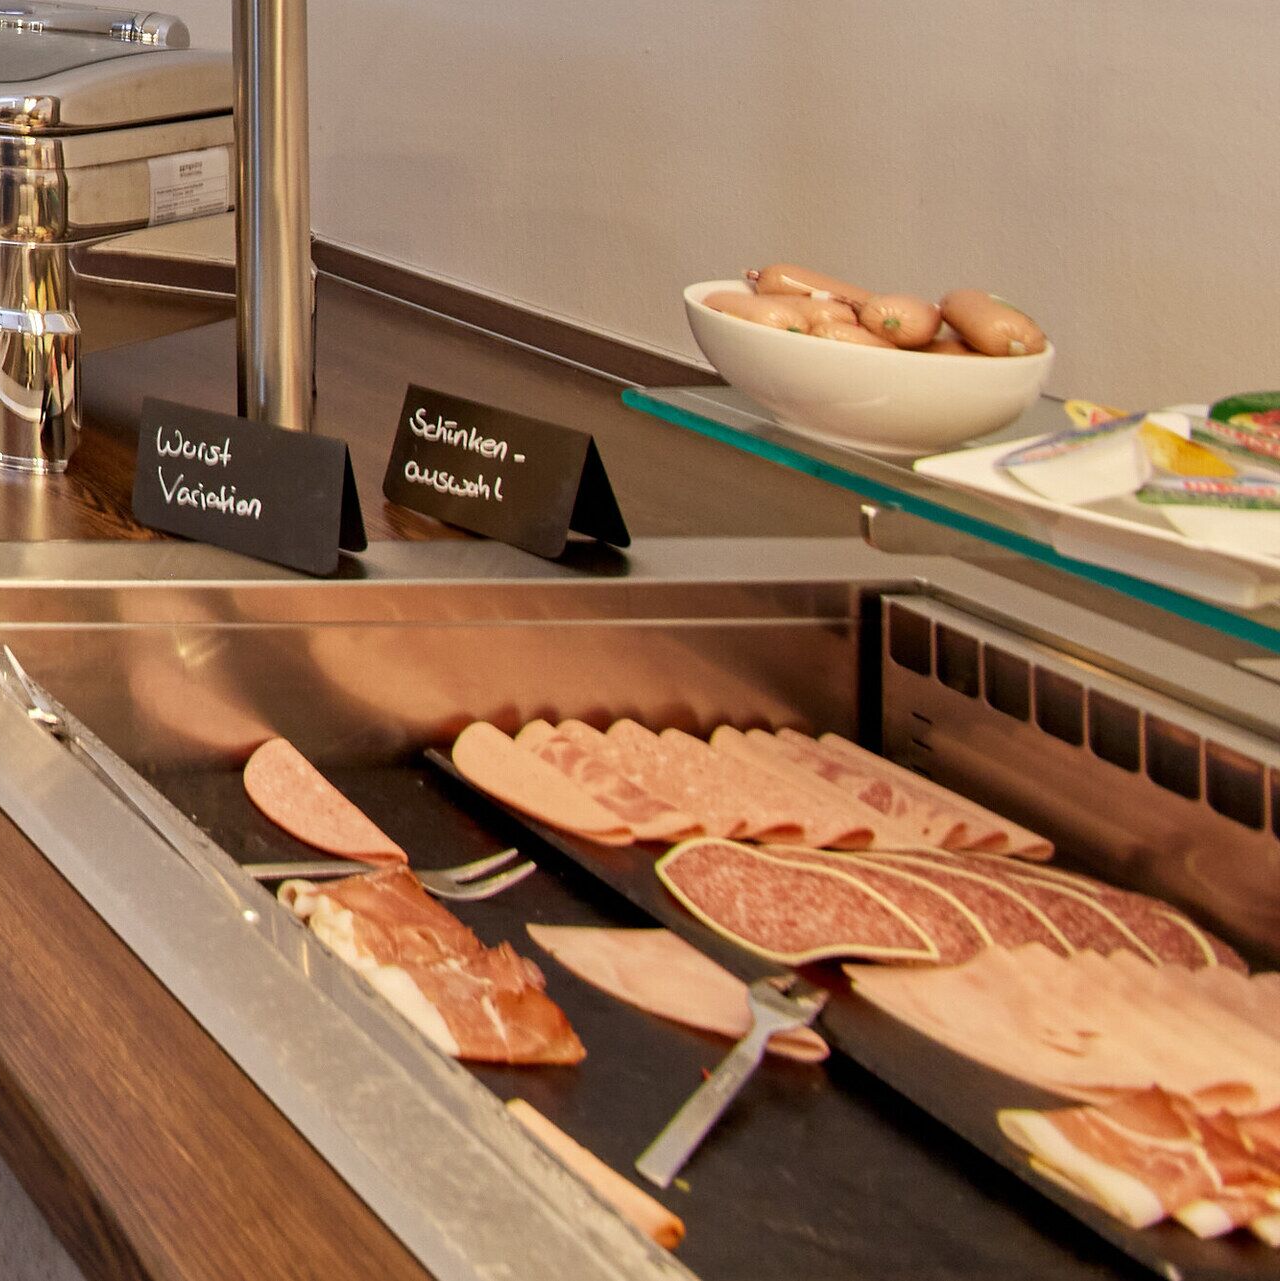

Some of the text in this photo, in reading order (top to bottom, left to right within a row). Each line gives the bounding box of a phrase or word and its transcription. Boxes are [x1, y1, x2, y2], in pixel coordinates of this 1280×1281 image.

[155, 425, 233, 467] Wurst
[156, 465, 263, 521] Variation
[403, 459, 505, 503] auswahl
